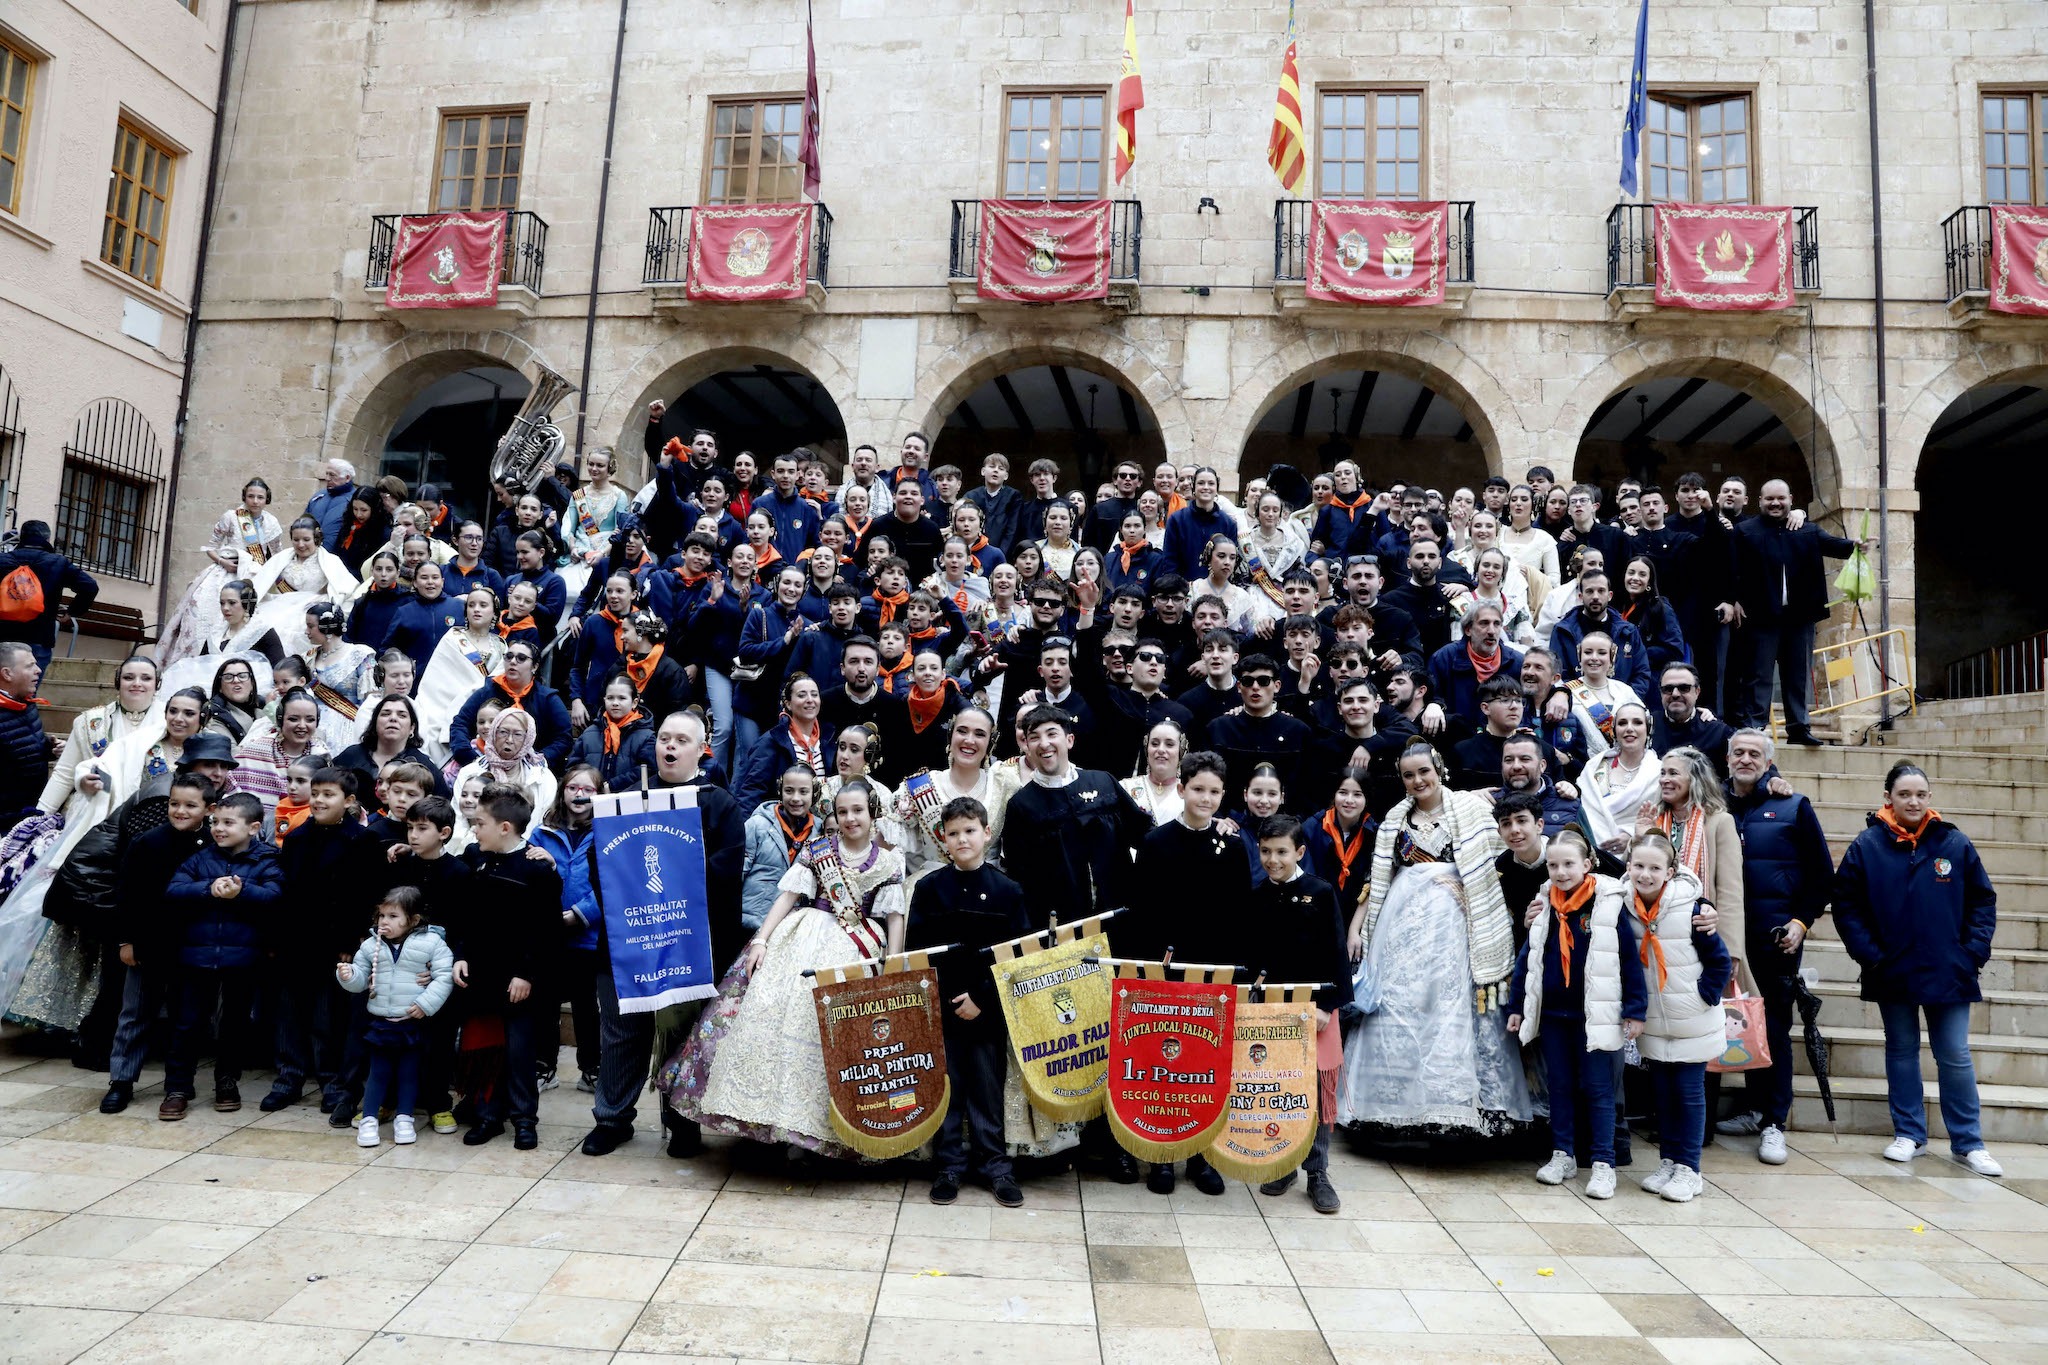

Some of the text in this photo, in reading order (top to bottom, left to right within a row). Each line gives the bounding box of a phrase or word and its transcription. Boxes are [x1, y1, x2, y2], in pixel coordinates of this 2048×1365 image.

[925, 808, 940, 823] 2025
[602, 824, 696, 855] PREMI GENERALITAT
[823, 869, 839, 882] 2025
[624, 900, 687, 916] GENERALITAT
[626, 910, 687, 927] VALENCIANA
[626, 935, 650, 944] MILLOR
[634, 966, 692, 983] FALLES 2025
[1013, 970, 1065, 998] AJUNTAMENT
[1065, 966, 1077, 981] DE
[832, 994, 923, 1024] JUNTA LOCAL FALLERA
[1130, 1002, 1214, 1017] AJUNTAMENT DE DÉNIA
[1122, 1022, 1151, 1046] JUNTA
[1152, 1021, 1180, 1033] LOCAL
[1182, 1022, 1219, 1048] FALLERA
[1238, 1027, 1265, 1040] LOCAL
[1266, 1026, 1302, 1040] FALLERA
[1021, 1033, 1079, 1063] MILLOR
[1046, 1044, 1108, 1077] INFANTIL
[1122, 1058, 1146, 1080] 1r
[1151, 1066, 1215, 1084] Premi
[1241, 1070, 1273, 1080] MANUEL
[1276, 1070, 1303, 1079] MARCO
[1052, 1087, 1076, 1097] FALLES
[1077, 1086, 1092, 1096] 2025
[1122, 1090, 1214, 1104] SECCIÓ ESPECIAL
[856, 1100, 888, 1112] Patrocina:
[1144, 1105, 1191, 1117] INFANTIL
[862, 1118, 886, 1129] FALLES
[887, 1121, 902, 1129] 2025
[905, 1106, 925, 1123] DENIA
[1133, 1117, 1156, 1133] FALLES
[1156, 1127, 1173, 1135] 2025
[1178, 1120, 1199, 1133] DENIA
[1226, 1139, 1250, 1155] FALLES
